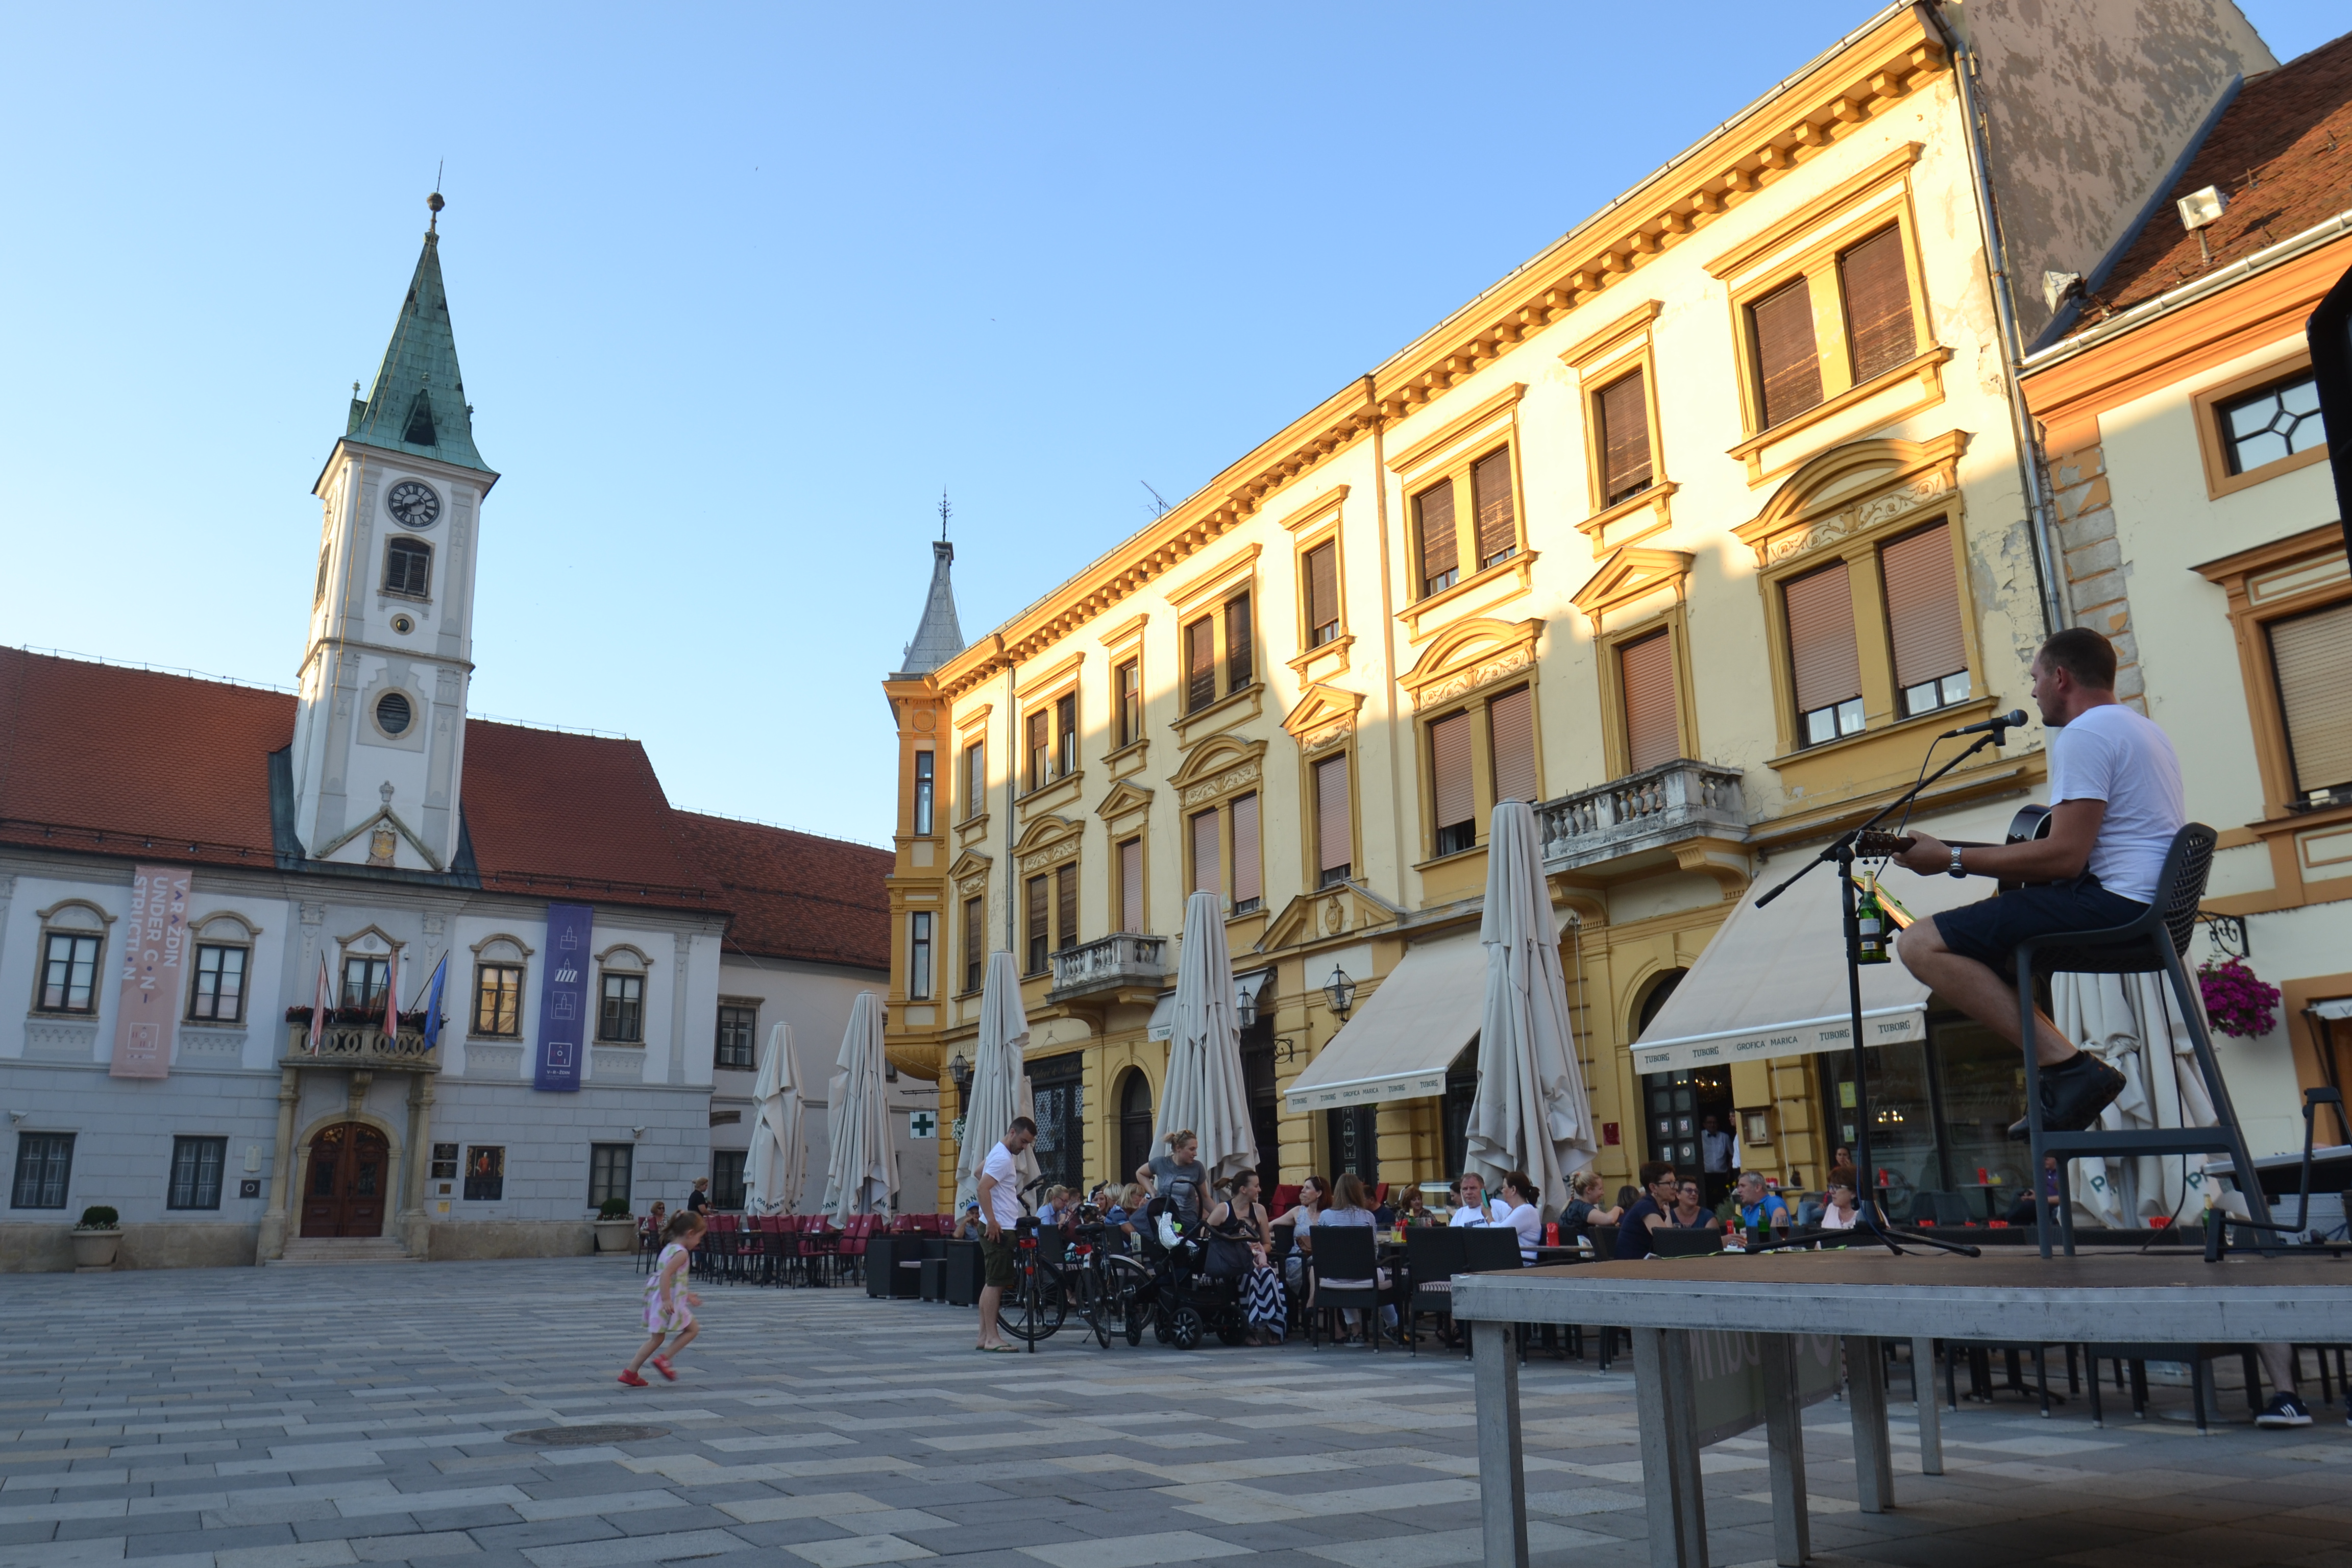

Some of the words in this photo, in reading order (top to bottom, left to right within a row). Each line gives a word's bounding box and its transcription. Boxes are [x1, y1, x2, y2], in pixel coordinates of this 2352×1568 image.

[146, 876, 168, 941] UNDER
[1157, 1028, 1171, 1037] TUBOR
[1645, 1053, 1670, 1064] TUBORG
[1693, 1046, 1719, 1058] TUBORG
[1736, 1040, 1766, 1051] GROFICA
[1770, 1036, 1798, 1046] MARICA
[1819, 1029, 1850, 1041] TUBORG
[1878, 1021, 1910, 1034] TUBORG
[1292, 1097, 1307, 1106] TUBORG
[1320, 1094, 1336, 1102] TUBORG
[1388, 1084, 1405, 1093] TUBORG
[1419, 1080, 1438, 1088] TUBORG
[959, 1194, 977, 1209] PAN
